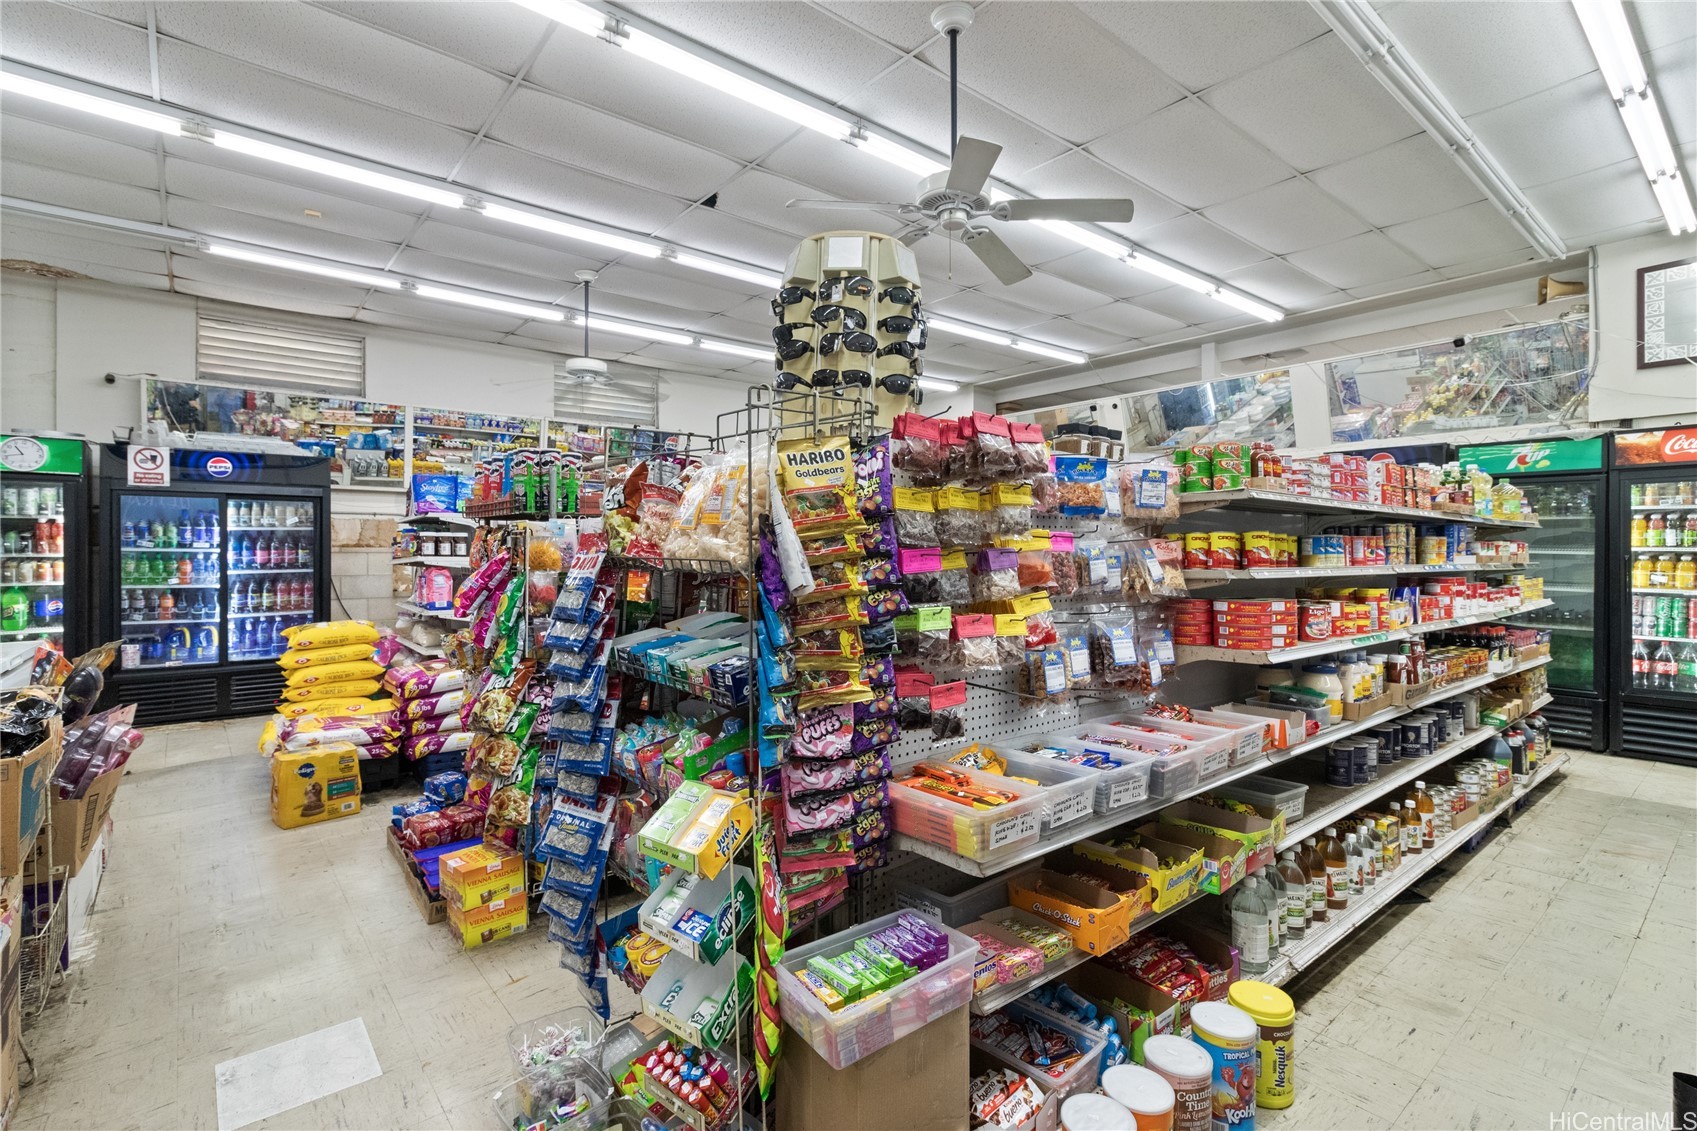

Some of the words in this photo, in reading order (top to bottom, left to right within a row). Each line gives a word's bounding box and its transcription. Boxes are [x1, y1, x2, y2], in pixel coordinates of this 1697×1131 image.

[786, 449, 846, 468] HARIBO
[795, 466, 845, 478] Goldbears
[867, 589, 891, 607] Egg
[802, 715, 841, 744] PUFFS
[467, 875, 492, 888] VIENNA
[493, 866, 521, 879] SAUSAGE
[469, 914, 495, 927] VIENNA
[496, 905, 525, 919] SAUSAGE
[973, 961, 997, 978] entos
[1223, 1051, 1250, 1060] TROPICAL
[1274, 1045, 1288, 1088] Nesquik
[978, 1081, 996, 1102] bueno
[1177, 1089, 1212, 1101] Countr
[1002, 1097, 1023, 1123] bueno
[1186, 1100, 1211, 1112] Time
